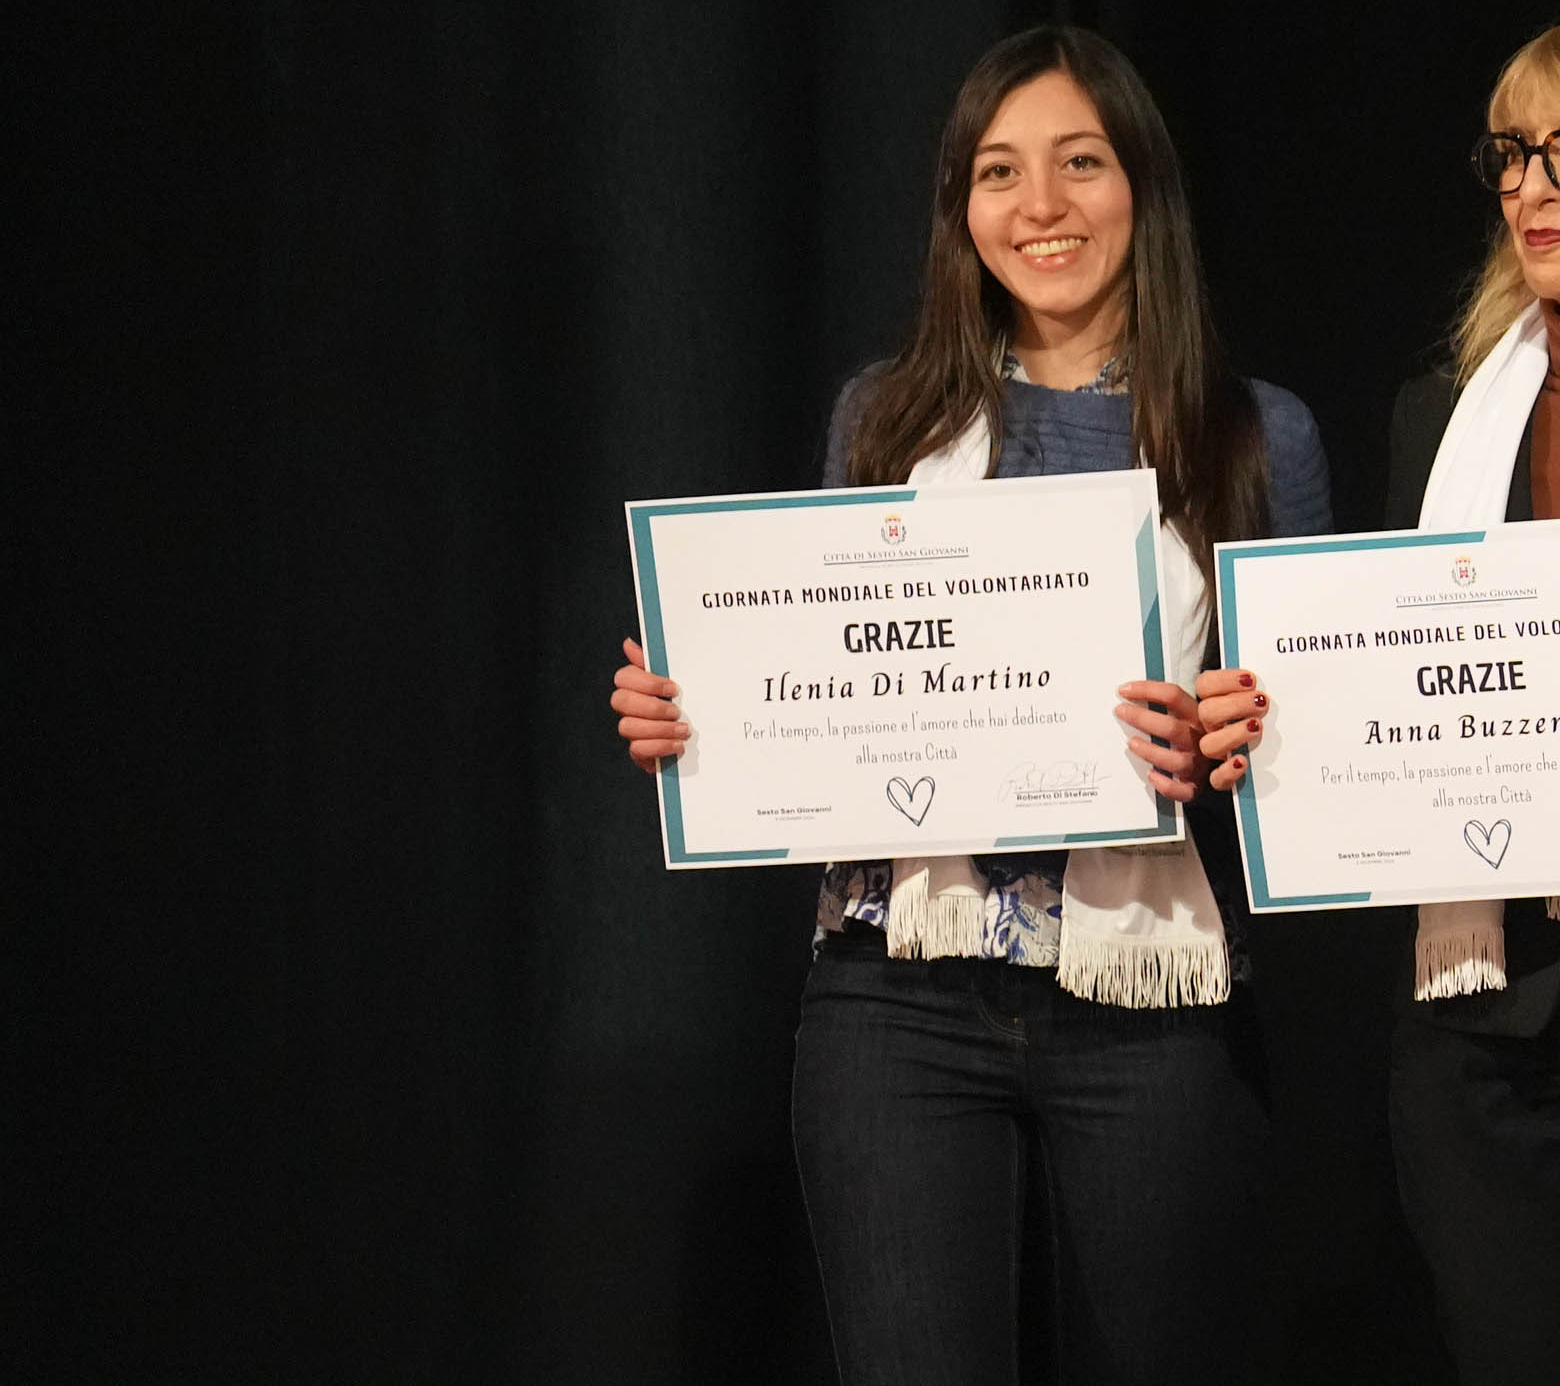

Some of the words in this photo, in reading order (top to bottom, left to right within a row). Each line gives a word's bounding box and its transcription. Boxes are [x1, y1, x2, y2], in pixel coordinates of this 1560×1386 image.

[701, 587, 794, 610] GIORNATA
[800, 582, 895, 605] MONDIALE
[902, 580, 937, 599] DEL
[943, 570, 1090, 597] VOLONTARIATO
[842, 617, 956, 654] GRAZIE
[1275, 631, 1367, 654] GIORNATA
[1373, 624, 1466, 648] MONDIALE
[1473, 622, 1508, 641] DEL
[763, 670, 855, 702] Ilenia
[870, 671, 904, 697] Di
[920, 661, 1051, 694] Martino
[1415, 659, 1528, 698] GRAZIE
[742, 720, 766, 741] Per
[767, 717, 777, 740] il
[779, 724, 825, 743] tempo,
[826, 715, 840, 737] la
[841, 719, 898, 741] passione
[900, 720, 909, 733] e
[961, 707, 986, 730] che
[987, 706, 1009, 728] hai
[1010, 703, 1068, 727] dedicato
[1363, 719, 1442, 746] Anna
[854, 742, 879, 765] alla
[880, 749, 923, 764] nostra
[1319, 764, 1344, 785] Per
[1344, 761, 1355, 784] il
[1356, 768, 1401, 787] tempo,
[1401, 758, 1416, 781] la
[1417, 763, 1473, 785] passione
[1474, 764, 1484, 776] e
[1534, 750, 1559, 772] che
[1431, 786, 1455, 809] alla
[1456, 791, 1498, 807] nostra
